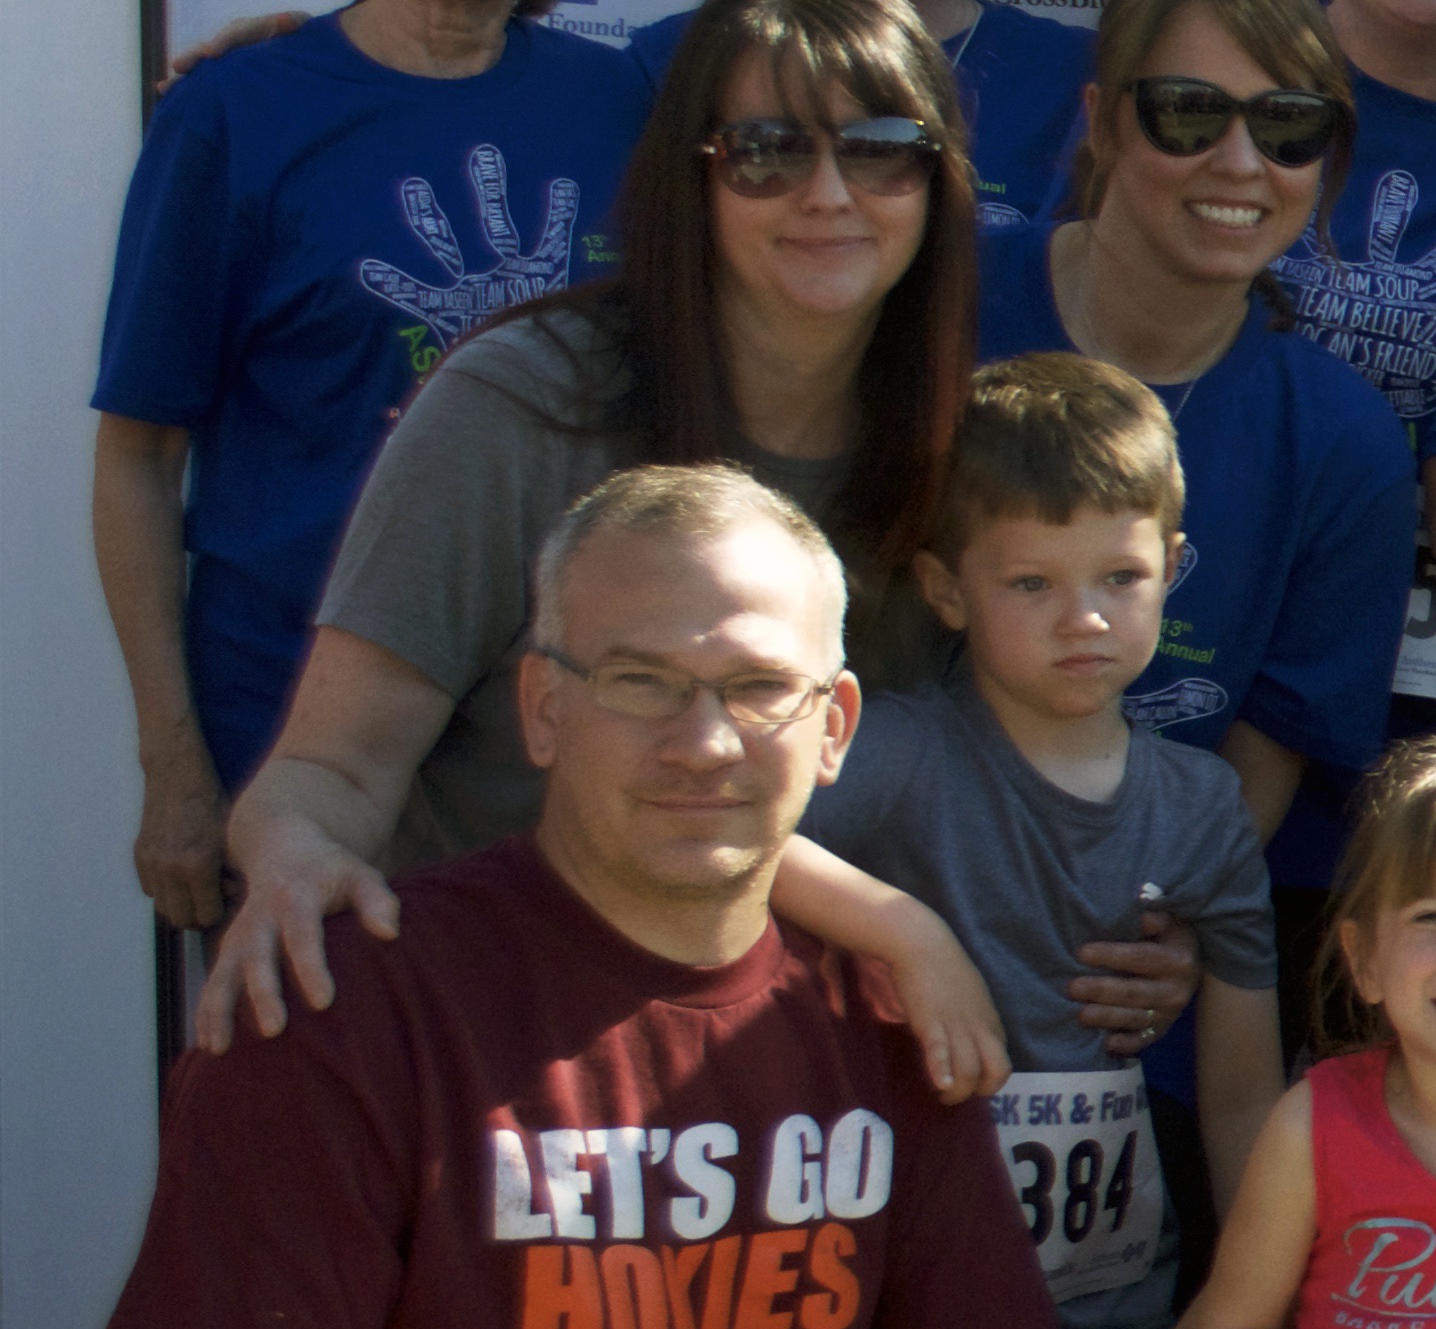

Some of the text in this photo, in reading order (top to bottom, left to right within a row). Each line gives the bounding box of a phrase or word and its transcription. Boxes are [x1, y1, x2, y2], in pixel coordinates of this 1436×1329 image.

[1376, 275, 1420, 301] SOUP
[1350, 301, 1425, 342] BELIEVE
[1028, 1092, 1095, 1126] 5K &
[494, 1107, 894, 1240] LET'S GO
[1011, 1130, 1138, 1248] 384
